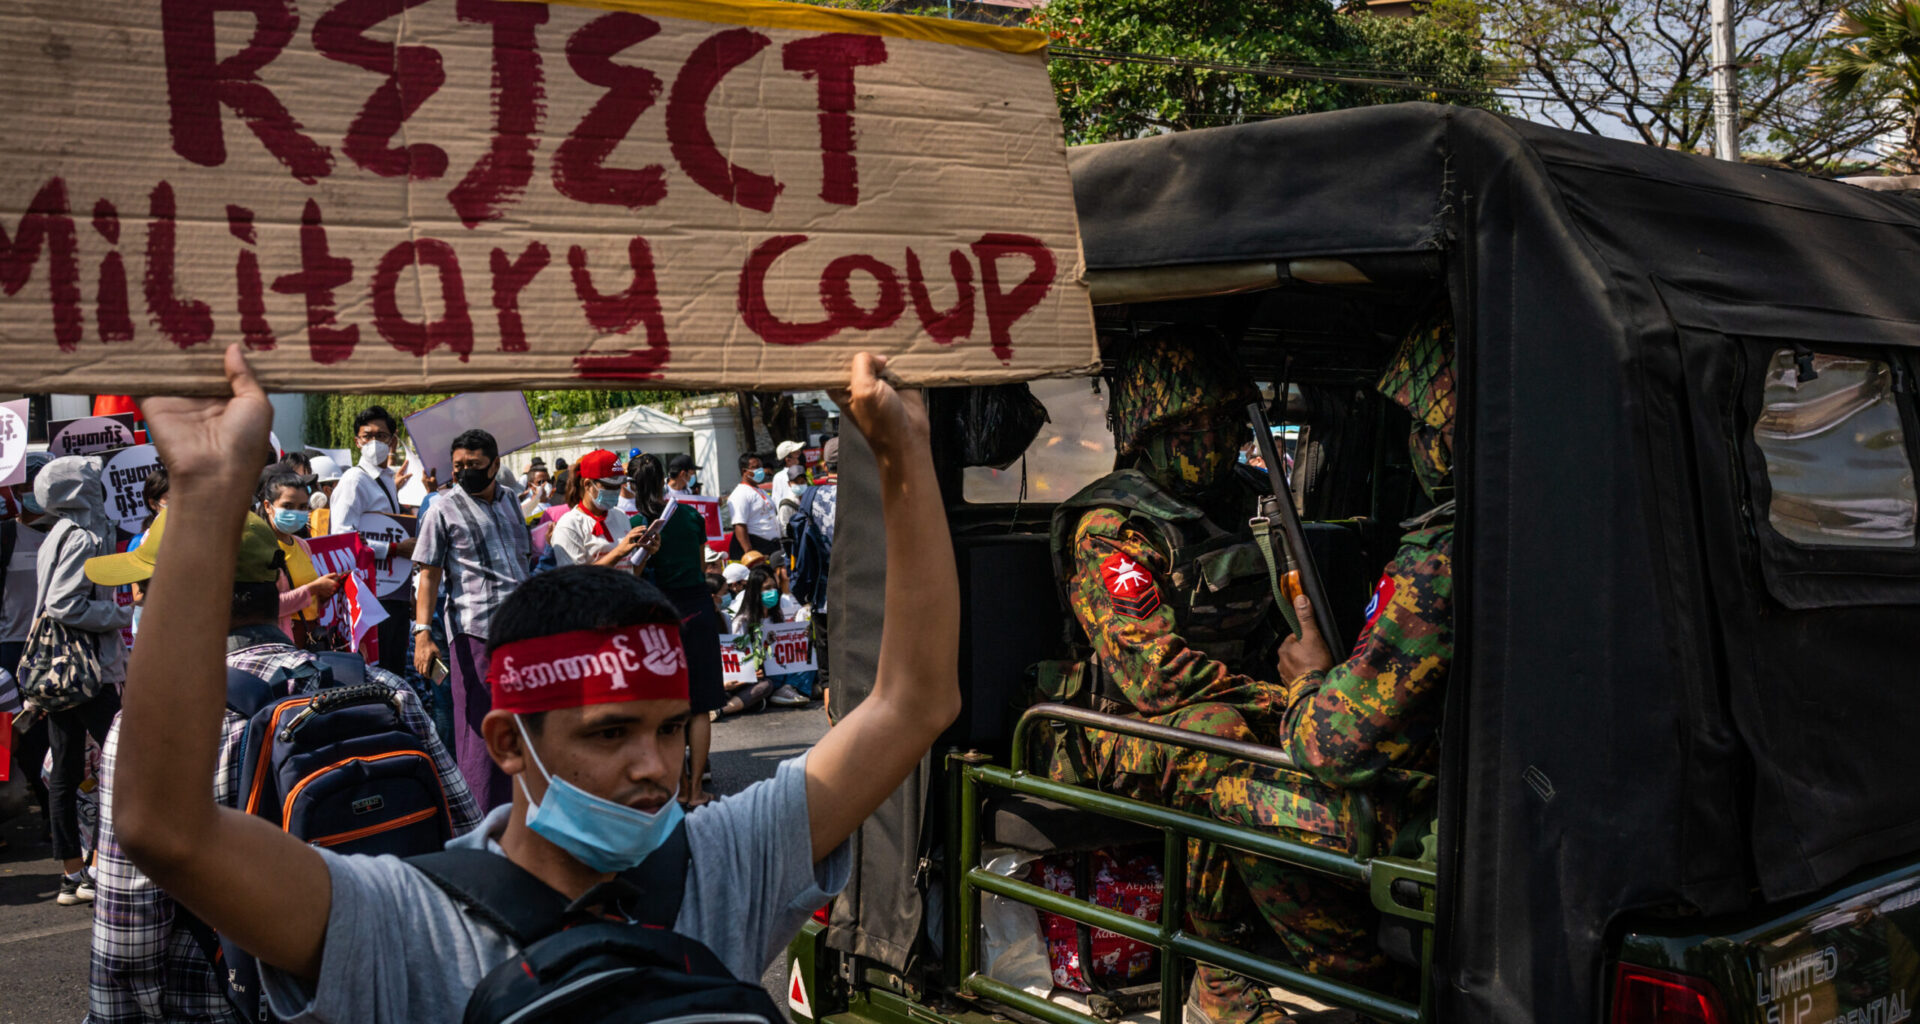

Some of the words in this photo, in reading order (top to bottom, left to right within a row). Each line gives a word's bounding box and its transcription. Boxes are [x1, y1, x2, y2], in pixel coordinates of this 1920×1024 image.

[161, 0, 888, 229] REJECT
[774, 641, 808, 665] CDM
[1756, 945, 1838, 1006] LIMITED
